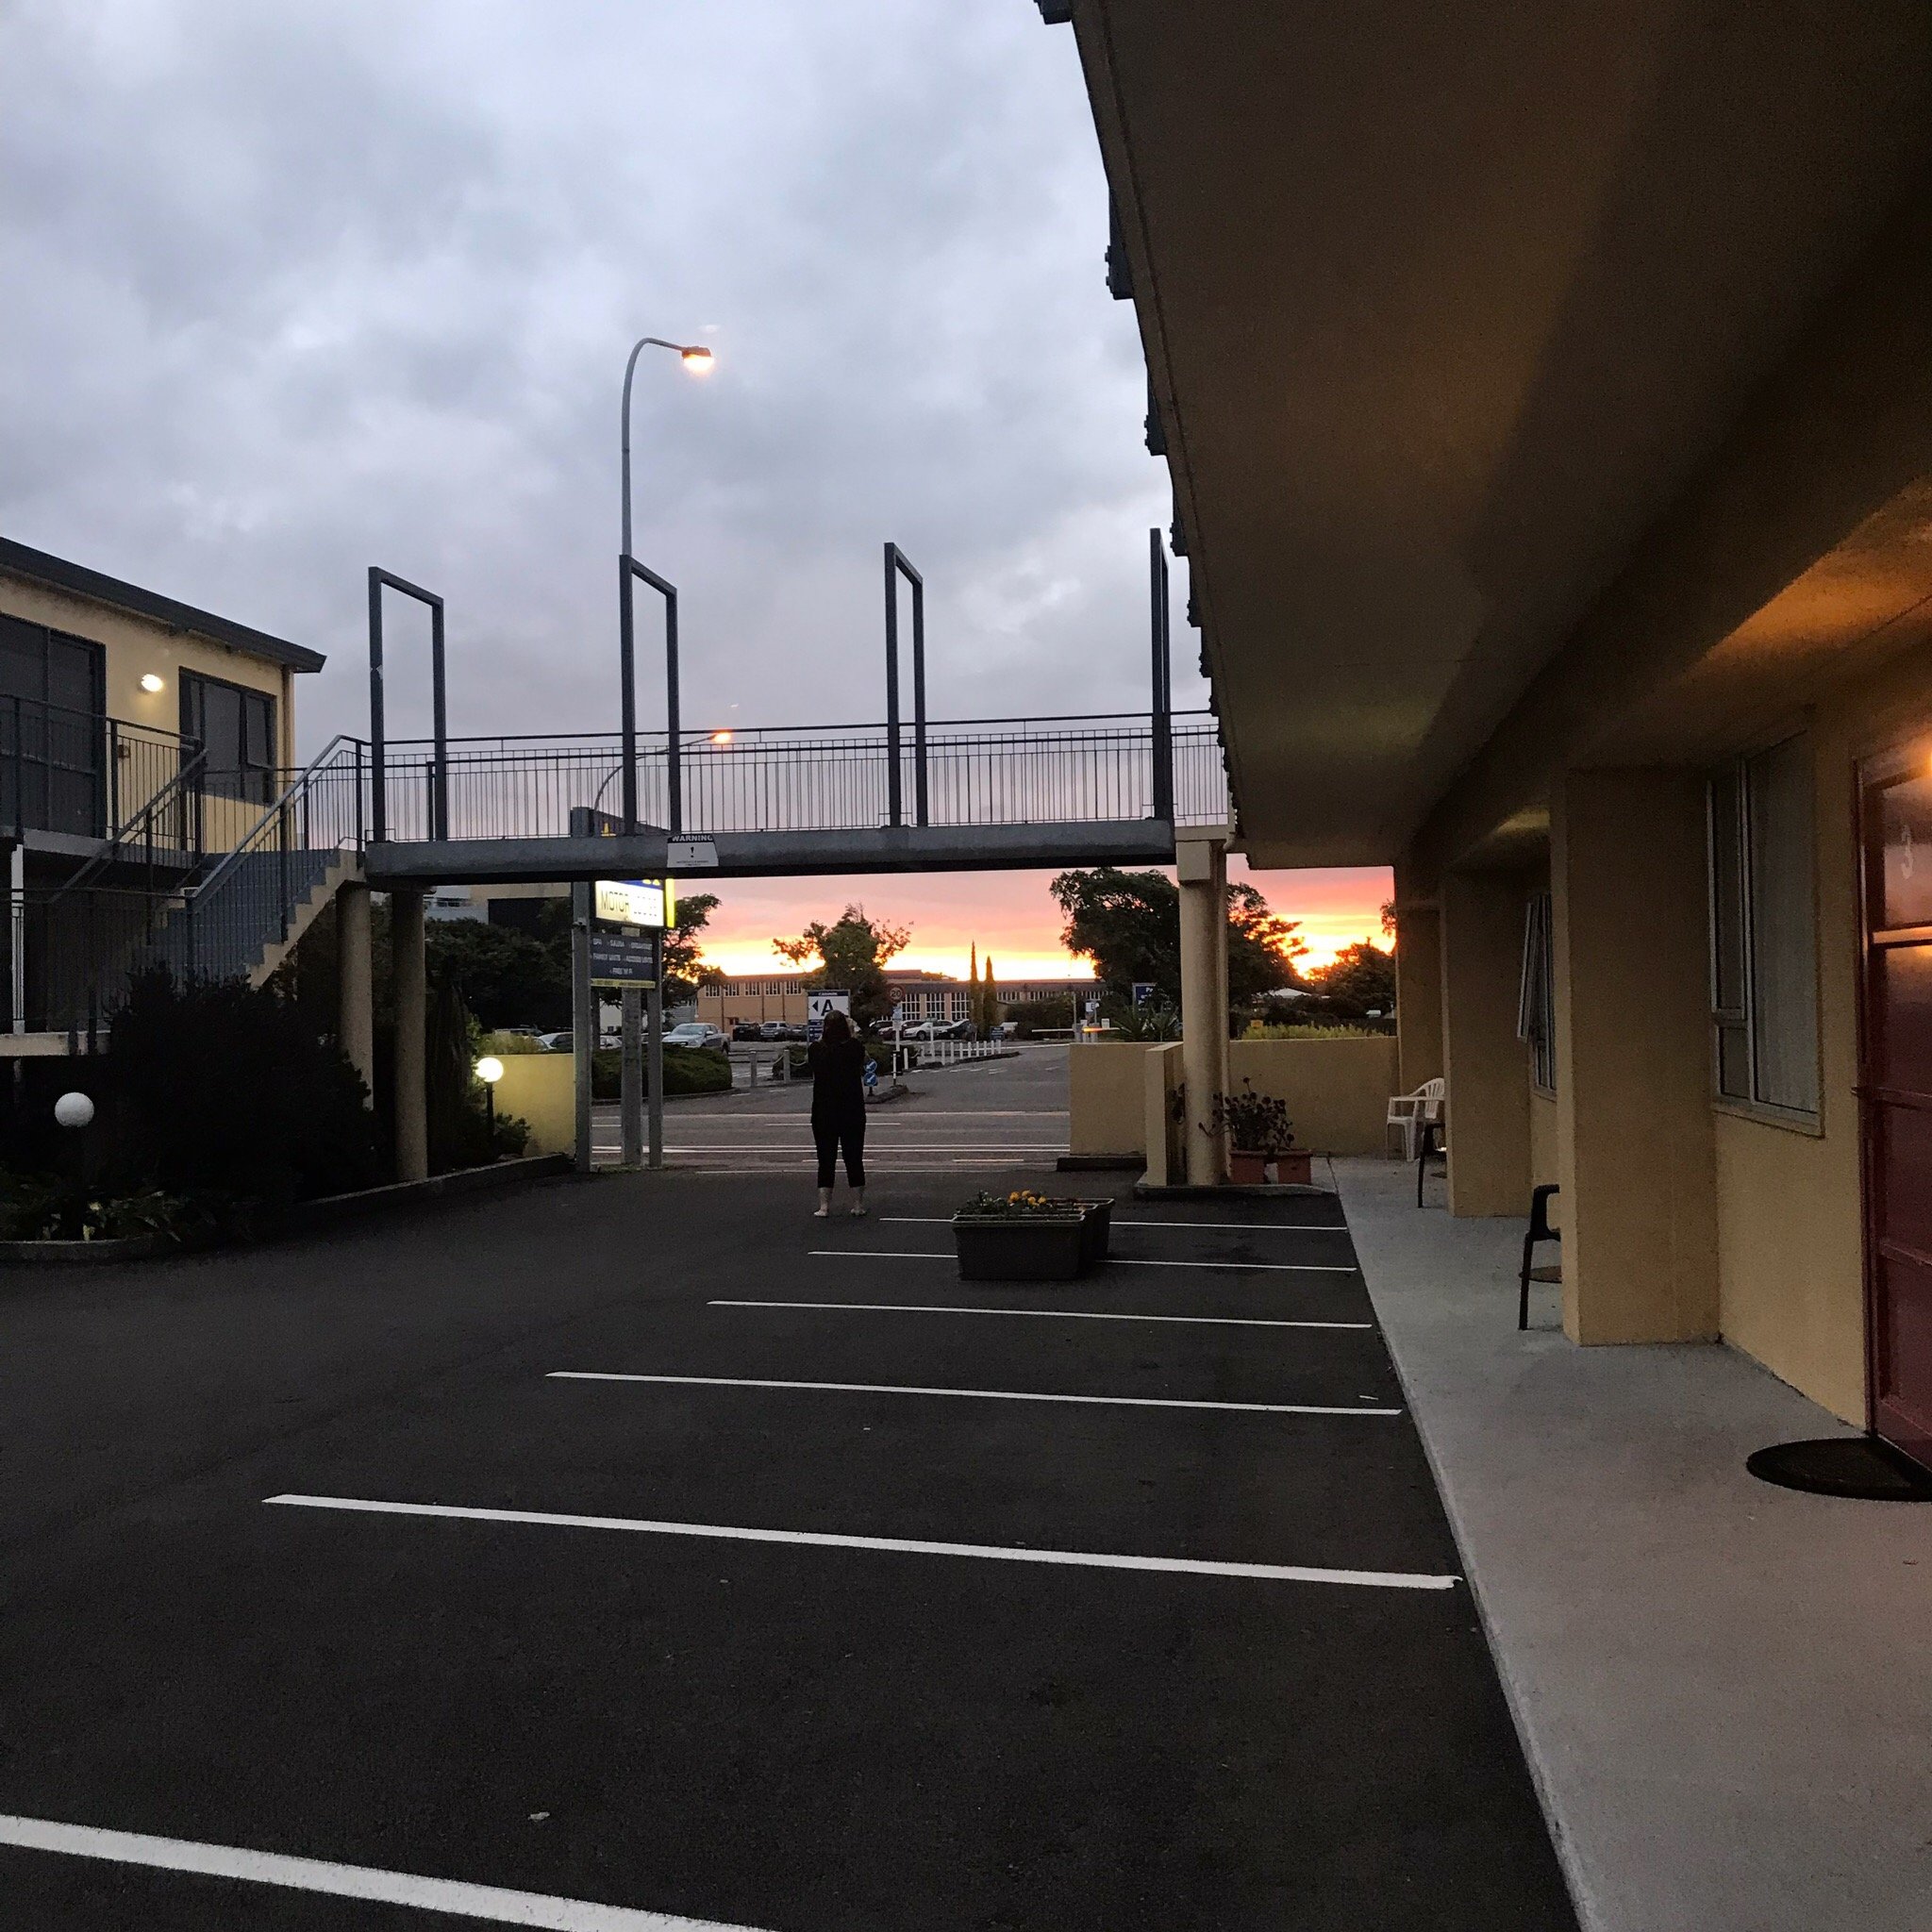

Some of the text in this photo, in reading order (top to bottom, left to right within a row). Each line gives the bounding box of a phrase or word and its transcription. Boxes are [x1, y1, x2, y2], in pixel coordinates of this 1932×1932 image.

[601, 890, 629, 912] MOTOR
[891, 990, 902, 998] 20
[821, 999, 835, 1016] A
